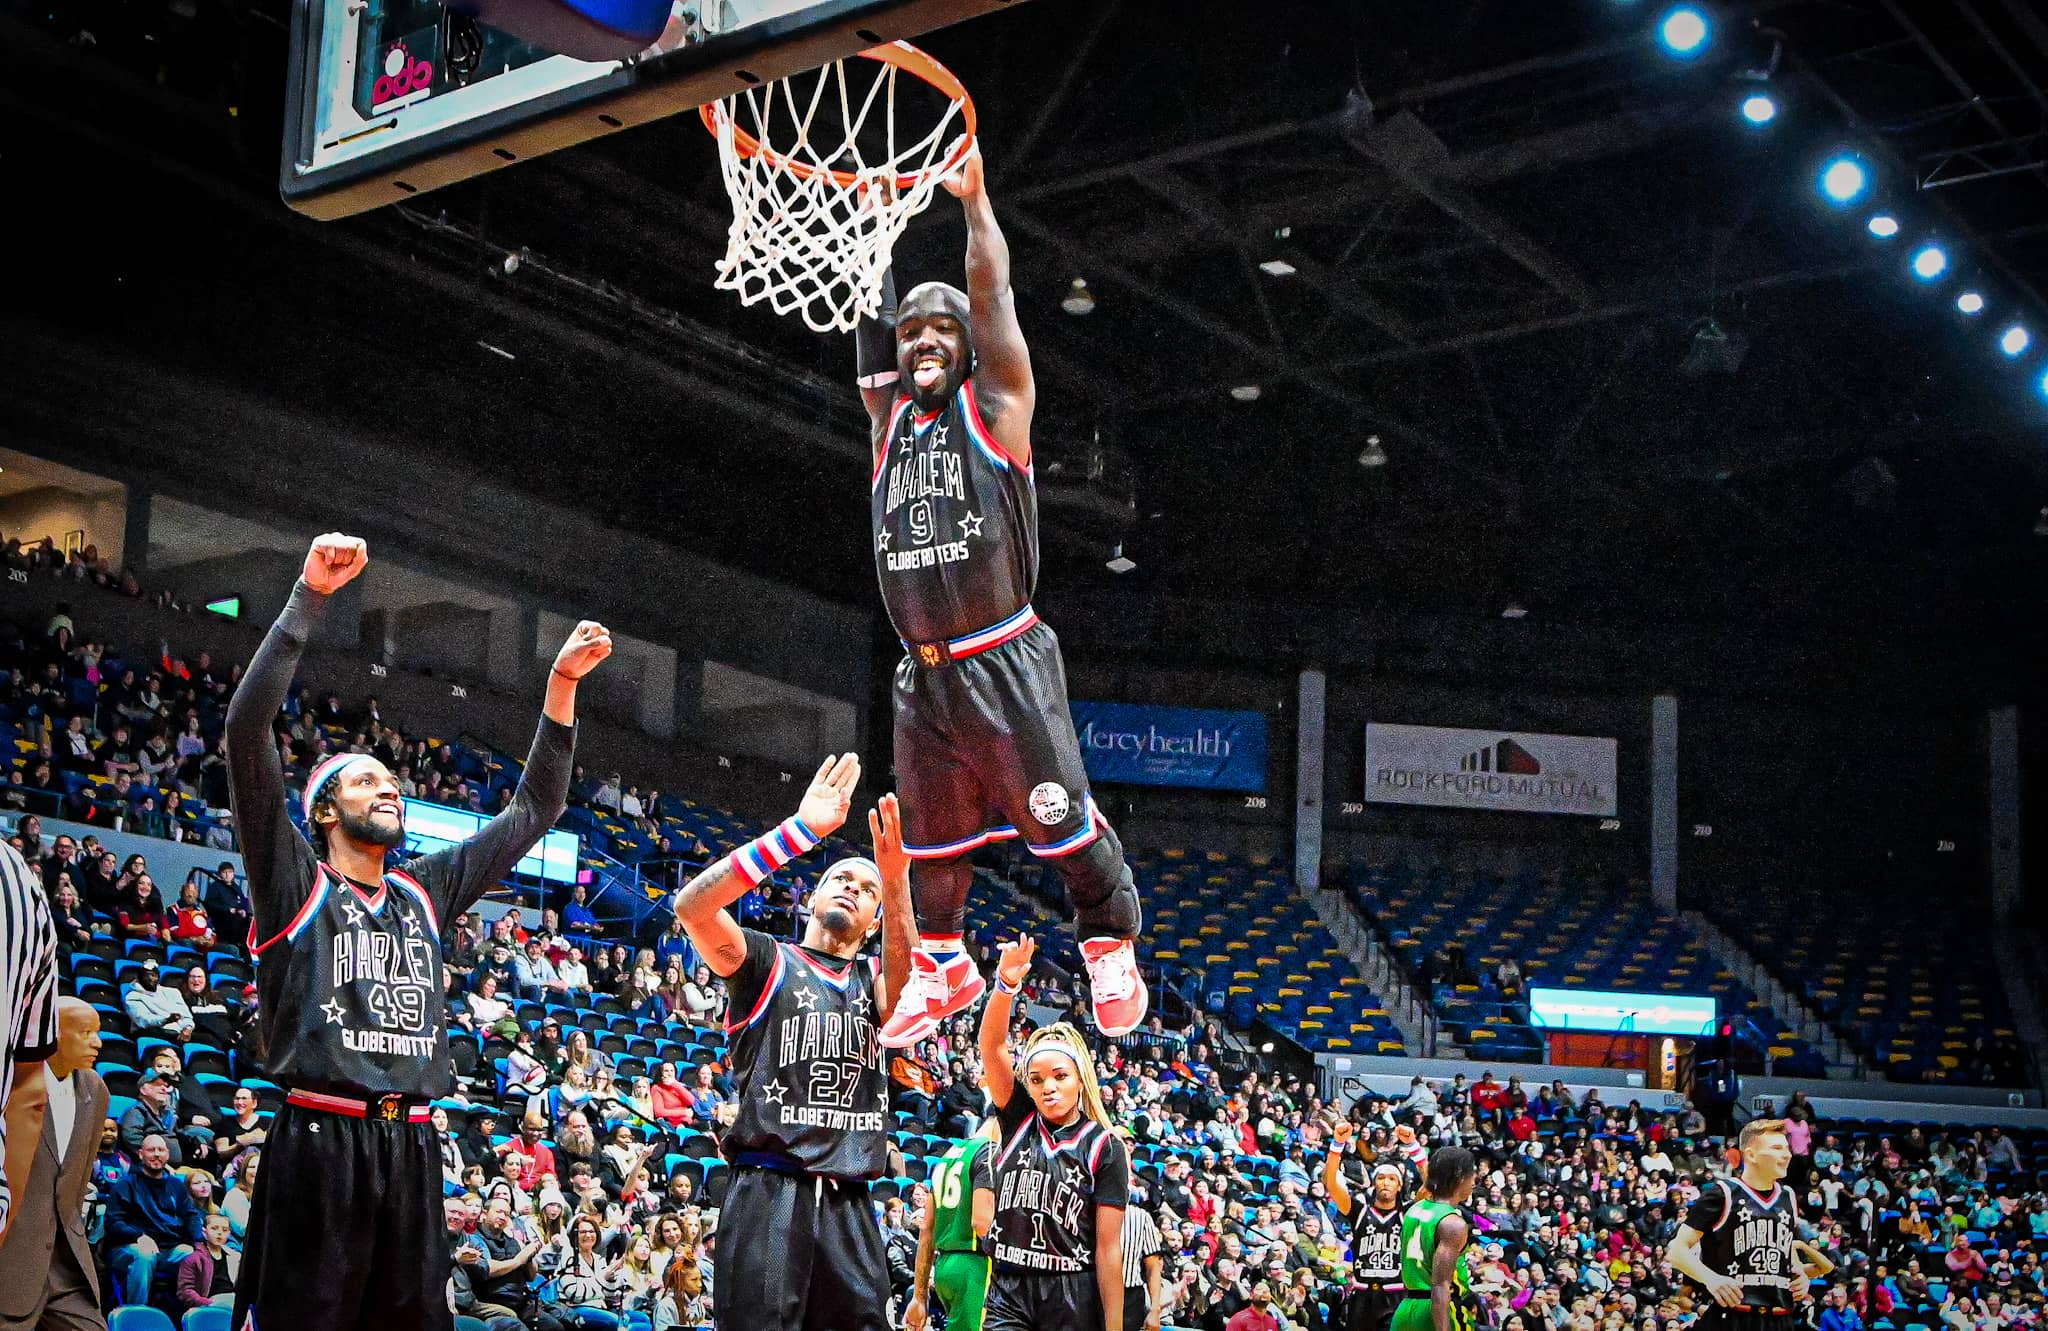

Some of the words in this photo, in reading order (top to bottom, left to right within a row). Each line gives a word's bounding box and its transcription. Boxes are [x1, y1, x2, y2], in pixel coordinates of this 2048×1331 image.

[909, 499, 934, 545] 9
[1377, 768, 1501, 794] ROCKFORD
[1507, 772, 1605, 800] MUTUAL
[1244, 797, 1266, 808] 208
[1342, 802, 1363, 814] 209
[1600, 818, 1621, 831] 209
[368, 984, 425, 1031] 49
[779, 1012, 886, 1076] HARLEM
[808, 1061, 862, 1108] 27
[780, 1105, 883, 1132] GLOBETROTTERS
[932, 1161, 964, 1209] 16
[998, 1169, 1084, 1237] HARLEM
[1030, 1213, 1047, 1250] 1
[1407, 1225, 1424, 1268] 4
[994, 1243, 1082, 1272] GLOBETROTTERS
[1369, 1250, 1394, 1270] 44
[1749, 1246, 1781, 1275] 48
